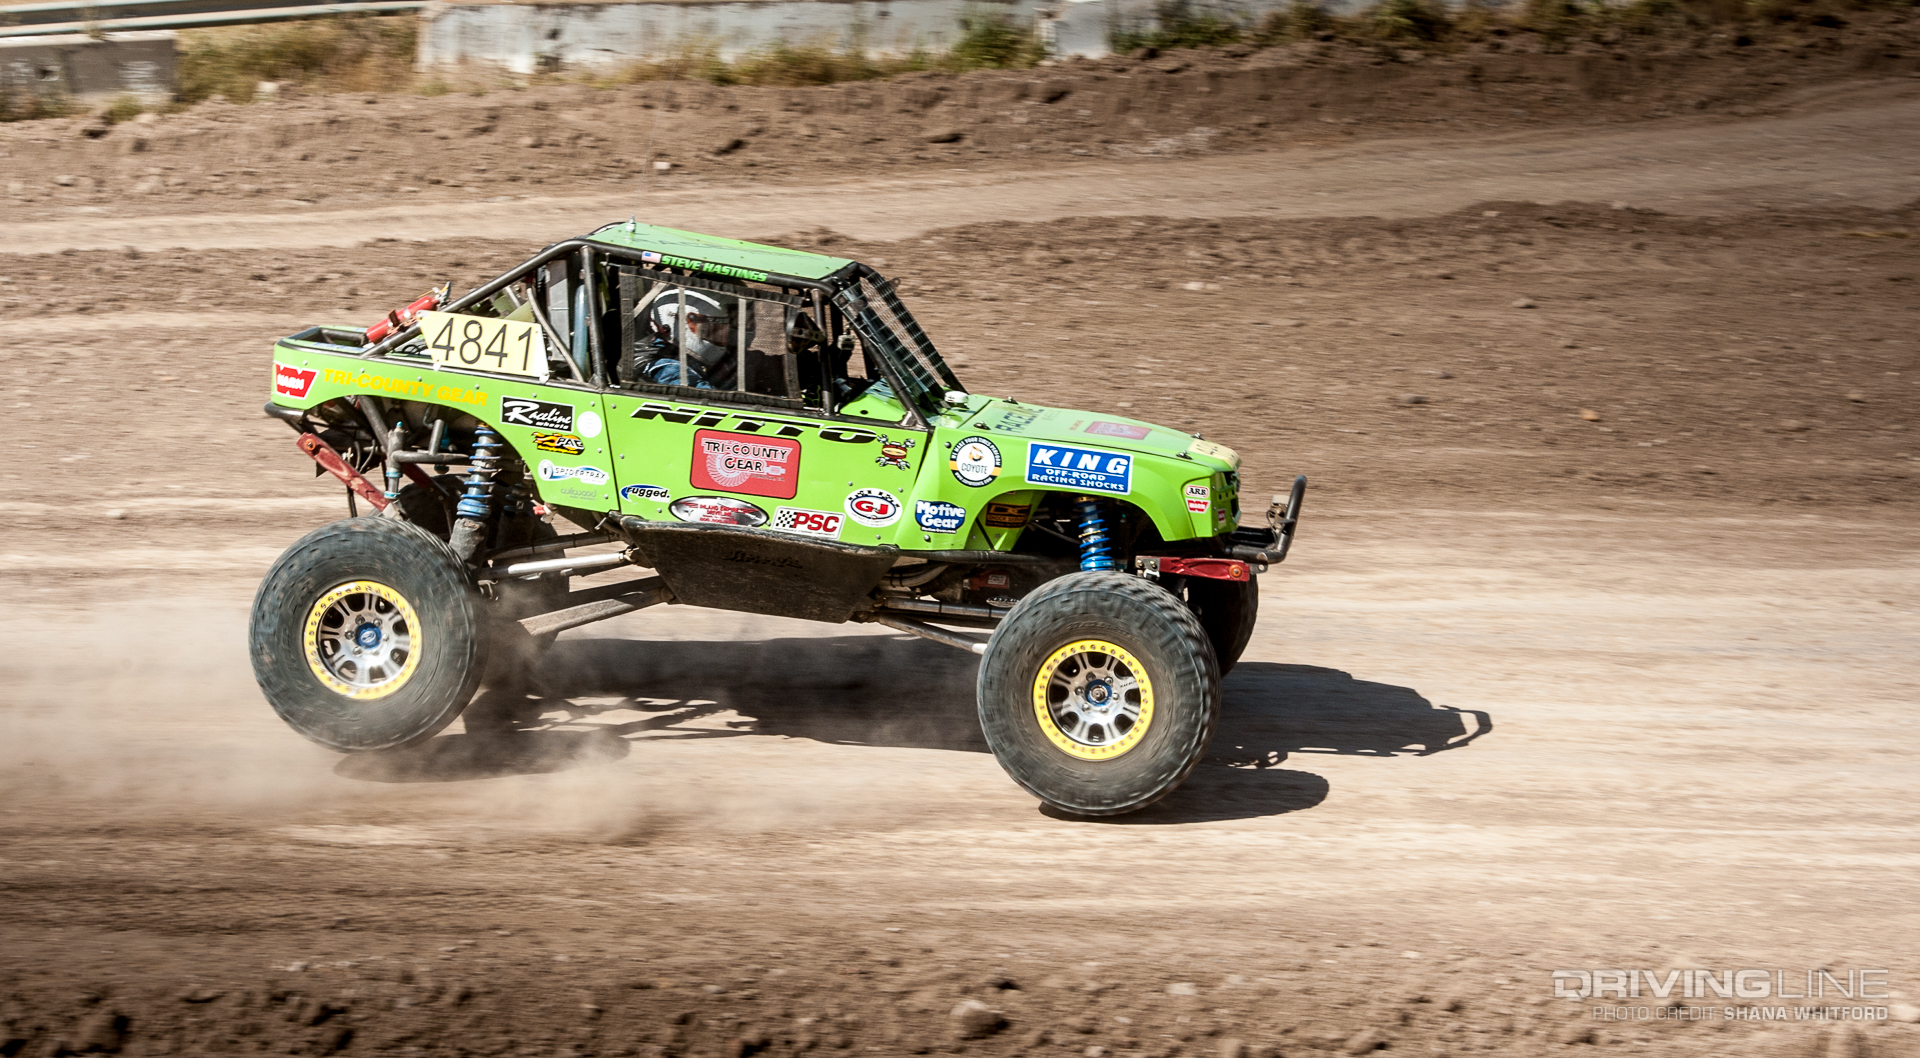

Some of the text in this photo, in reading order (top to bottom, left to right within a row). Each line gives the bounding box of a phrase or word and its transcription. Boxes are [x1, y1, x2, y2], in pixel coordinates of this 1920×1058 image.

[661, 254, 769, 283] STEVE HASTINGS
[432, 317, 533, 371] 4841
[277, 373, 305, 389] WARN
[323, 368, 488, 406] TRI-COUNTY GEAR
[503, 401, 572, 424] Raceline
[535, 421, 569, 430] wheels
[631, 402, 877, 443] NITTO
[705, 441, 788, 459] TRI-COUNTY
[724, 458, 763, 472] GEAR
[961, 462, 989, 475] COYOTE
[1033, 448, 1128, 474] KING
[555, 467, 606, 479] SPIDERTRAX
[1045, 468, 1106, 481] OFF-ROAD
[1032, 473, 1125, 491] RACING SHOCKS
[1189, 487, 1206, 495] ARB
[917, 501, 965, 517] Motive
[791, 512, 839, 532] PSC
[921, 514, 959, 529] Gear
